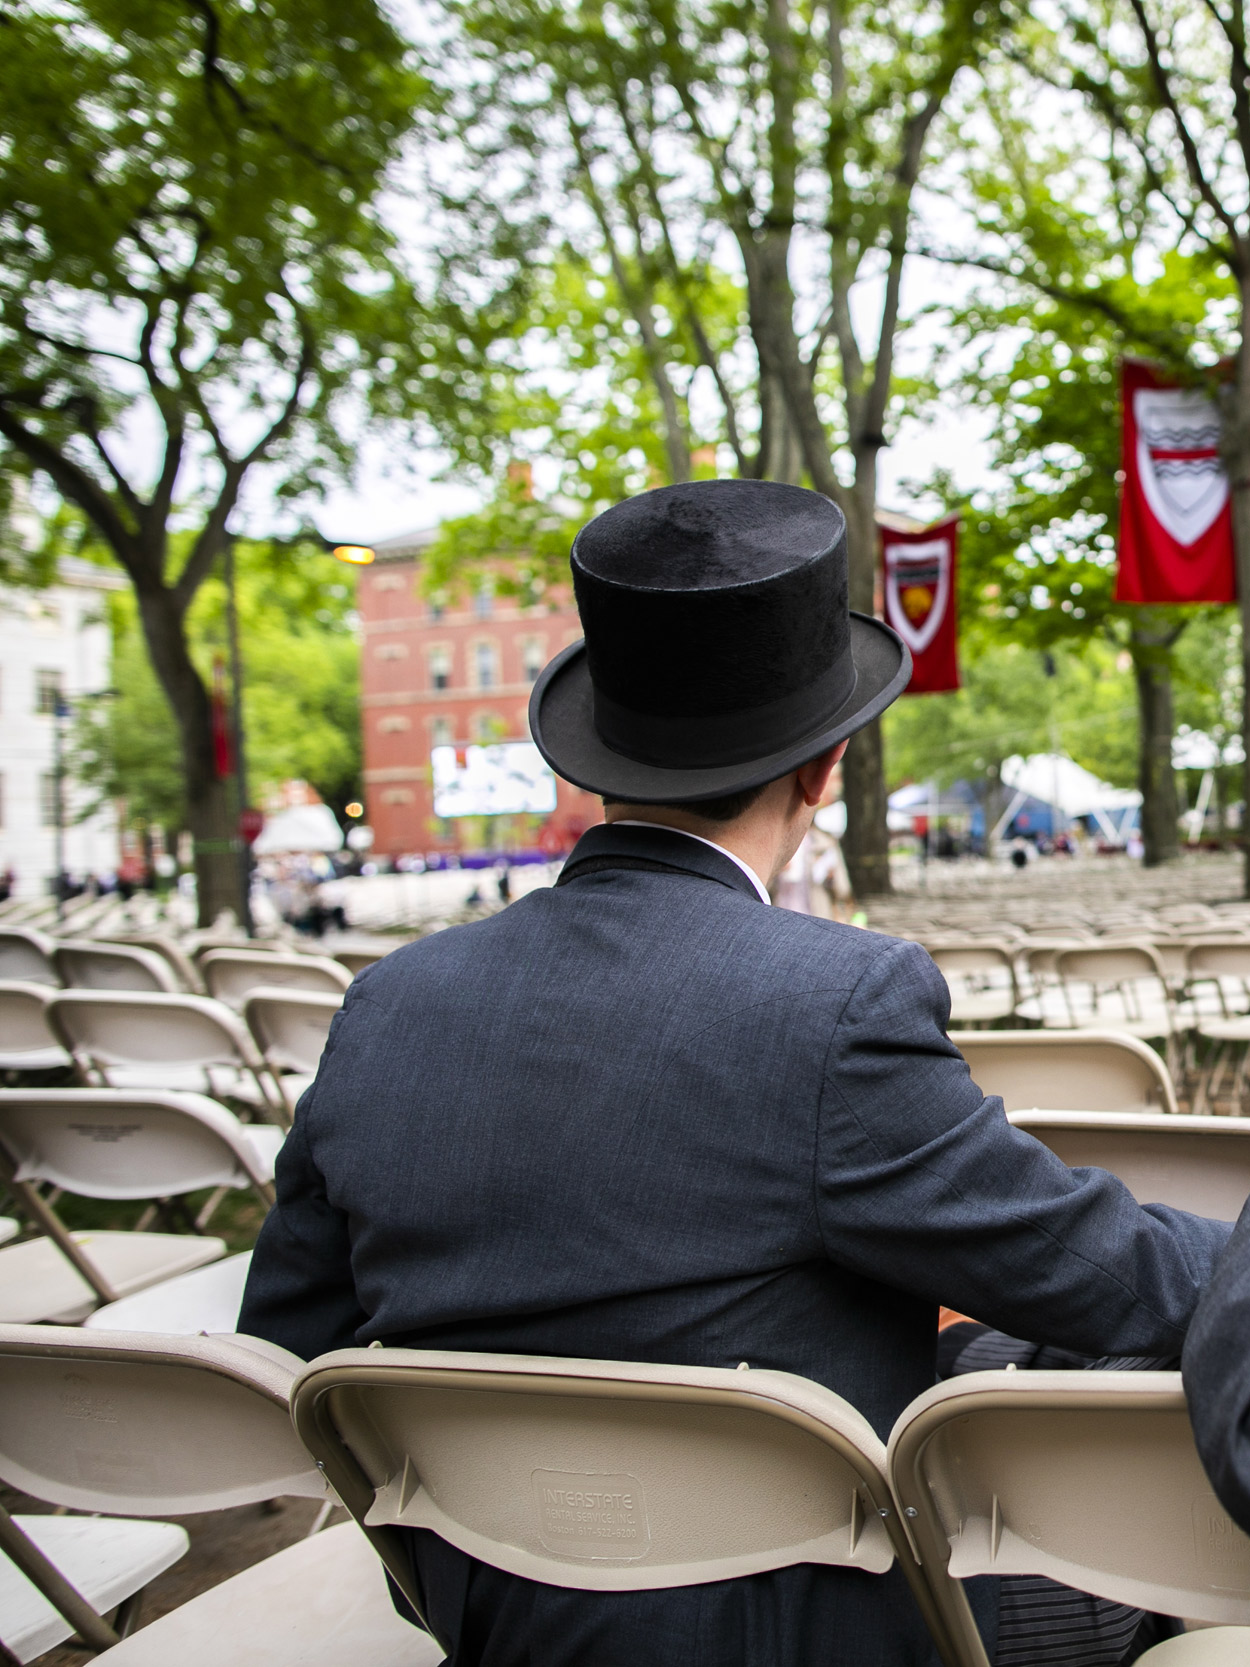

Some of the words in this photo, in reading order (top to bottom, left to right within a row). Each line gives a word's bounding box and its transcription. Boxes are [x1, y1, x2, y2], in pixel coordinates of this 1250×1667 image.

[543, 1488, 633, 1509] INTERSTATE
[546, 1508, 576, 1522] RENTAL
[577, 1511, 615, 1525] SERVICE,
[617, 1513, 636, 1525] INC.
[547, 1522, 574, 1535] Boston
[578, 1526, 637, 1539] 617-522-6200
